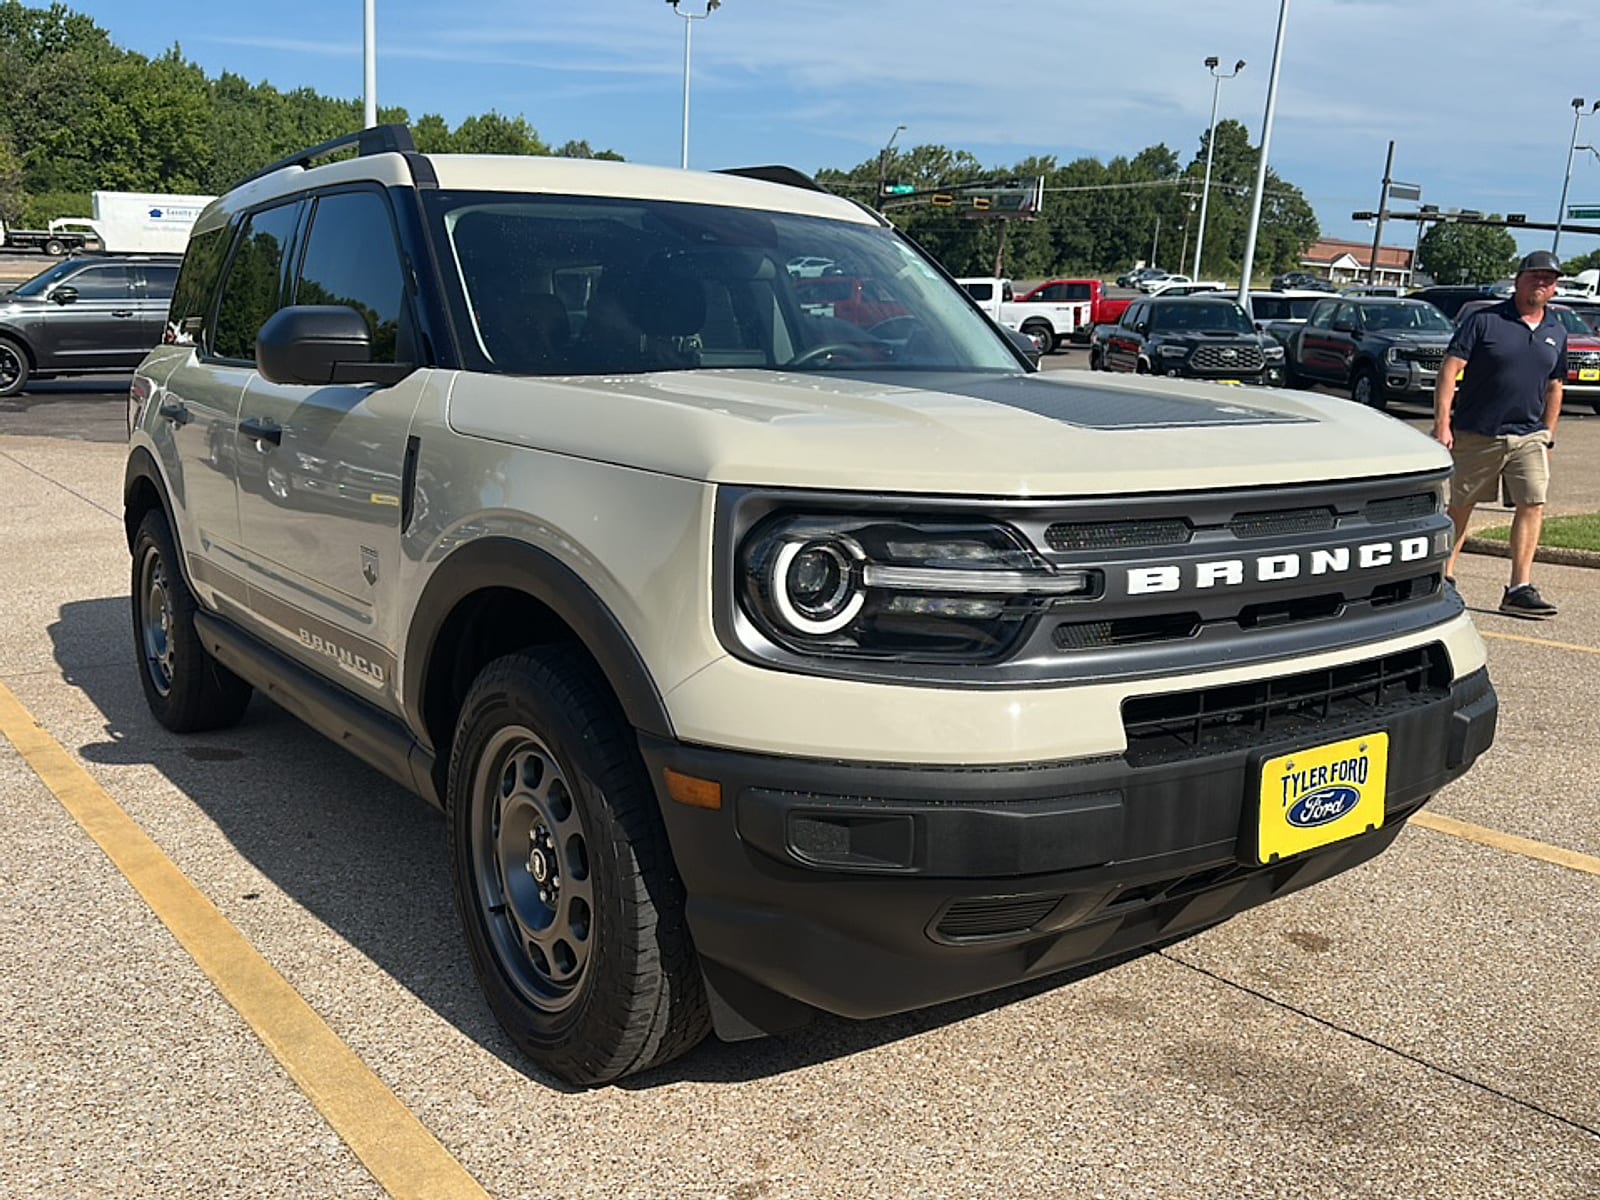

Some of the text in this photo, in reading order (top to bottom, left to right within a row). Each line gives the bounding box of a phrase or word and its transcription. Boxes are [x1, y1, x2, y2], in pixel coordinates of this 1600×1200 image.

[1127, 537, 1428, 595] BRONCO
[298, 628, 384, 681] BRONCO
[1281, 756, 1368, 807] TYLER FORD
[1300, 791, 1346, 823] Ford
